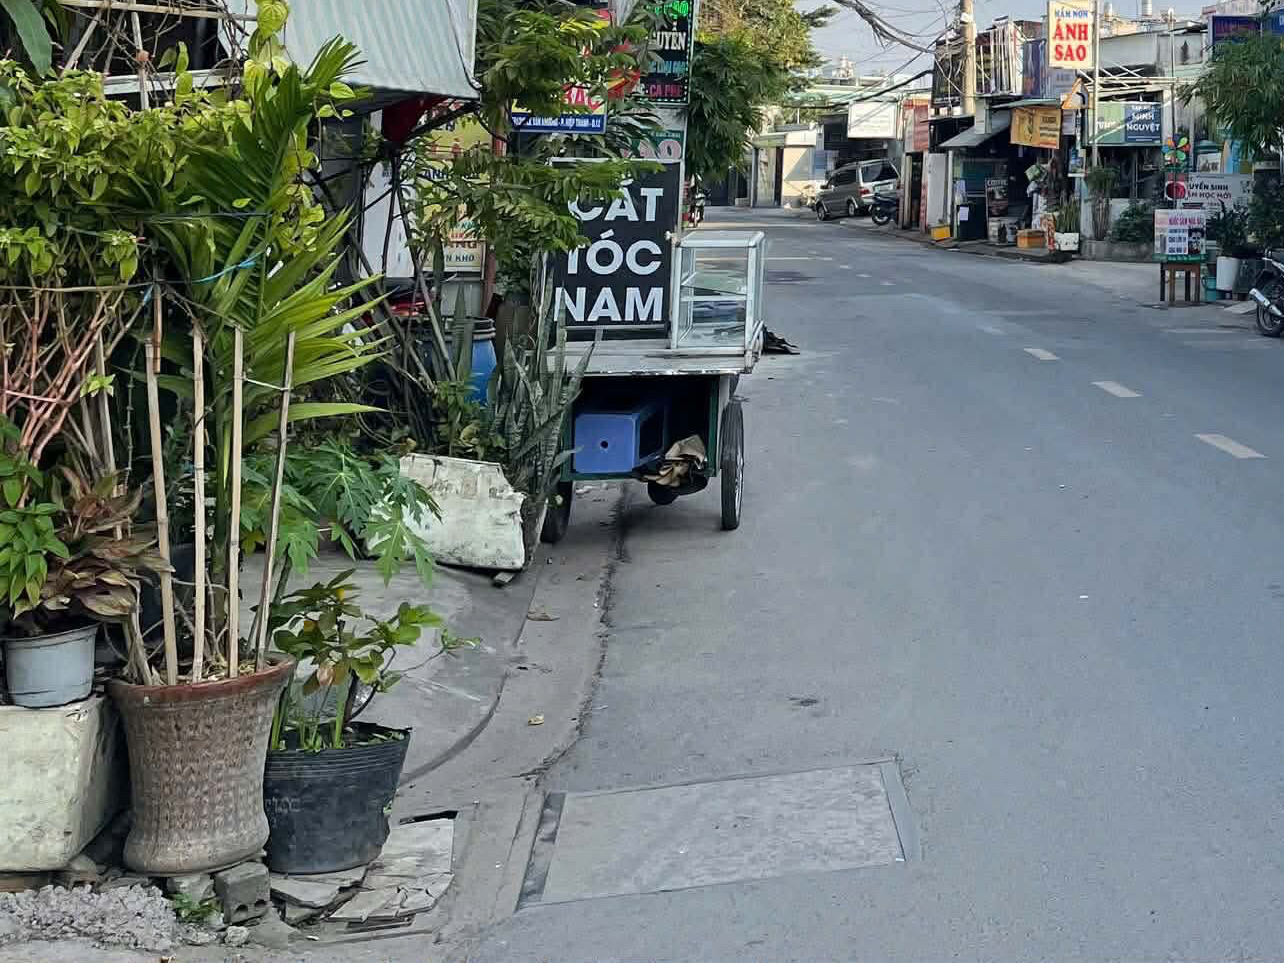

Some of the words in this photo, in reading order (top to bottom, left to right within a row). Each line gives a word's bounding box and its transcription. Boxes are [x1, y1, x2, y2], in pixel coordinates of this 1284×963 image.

[1055, 45, 1086, 62] SAO
[568, 229, 662, 275] TÓC
[554, 287, 664, 322] NAM
